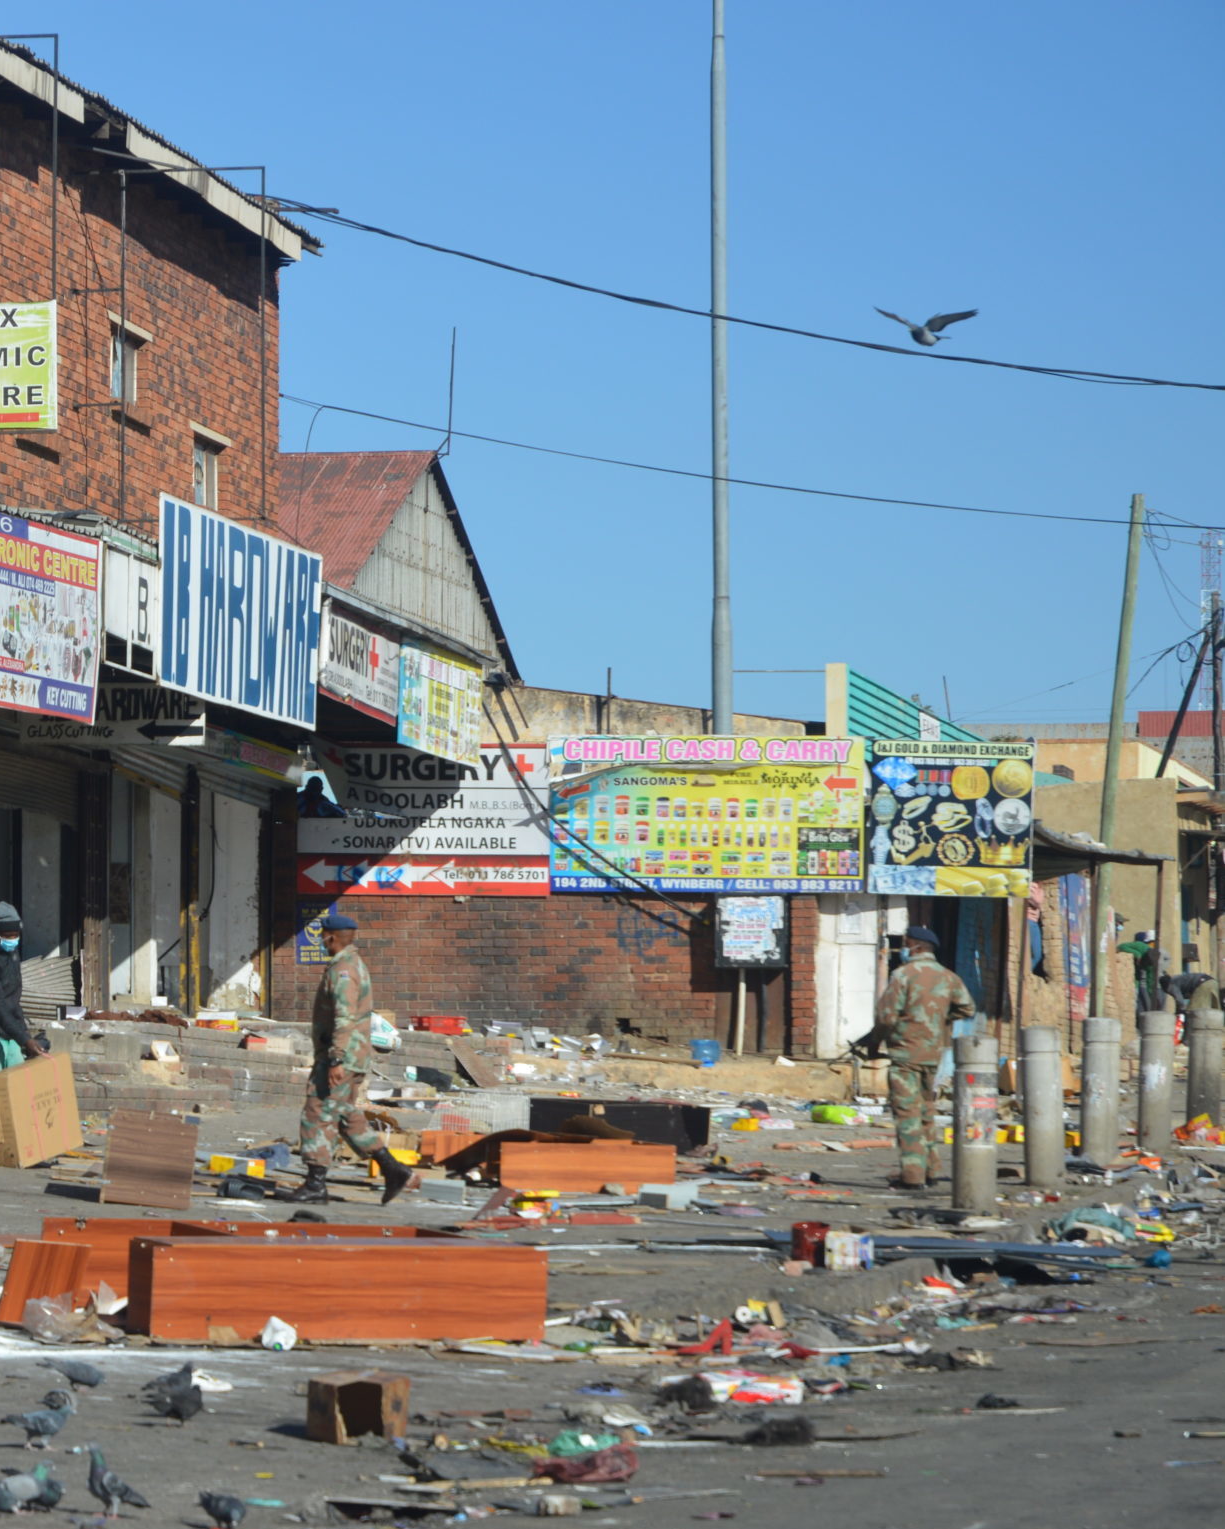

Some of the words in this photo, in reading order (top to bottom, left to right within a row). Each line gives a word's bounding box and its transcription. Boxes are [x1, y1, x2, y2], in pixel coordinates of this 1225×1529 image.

[42, 548, 97, 587] CENTRE
[197, 513, 321, 726] HARDWARE
[329, 615, 370, 678] SURGERY
[46, 686, 60, 705] KEY
[59, 689, 88, 713] CUTTING
[96, 684, 202, 722] ARDWARE
[563, 738, 661, 762] CHIPILE
[665, 739, 736, 762] CASH
[739, 740, 762, 761] &
[764, 740, 853, 763] CARRY
[895, 743, 920, 755] GOLD
[931, 744, 977, 756] DIAMOND
[980, 745, 1029, 757] EXCHANGE
[344, 753, 503, 782] SURGERY
[613, 776, 688, 787] SANGOMA'S
[347, 788, 360, 801] A
[364, 793, 464, 810] DOOLABH
[354, 816, 447, 829] UDOKOTELA
[451, 816, 506, 829] NGAKA
[342, 836, 396, 850] SONAR
[400, 836, 430, 851] (TV)
[434, 837, 517, 850] AVAILABLE
[443, 869, 464, 880] Tel:
[468, 870, 489, 881] 011
[492, 870, 515, 880] 786
[517, 870, 546, 881] 5701
[554, 877, 578, 889] 194
[580, 878, 607, 889] 2ND
[610, 878, 658, 891] STREET,
[661, 879, 724, 890] WYNBERG
[735, 880, 771, 890] CELL:
[801, 881, 825, 891] 983
[827, 881, 861, 892] 9211
